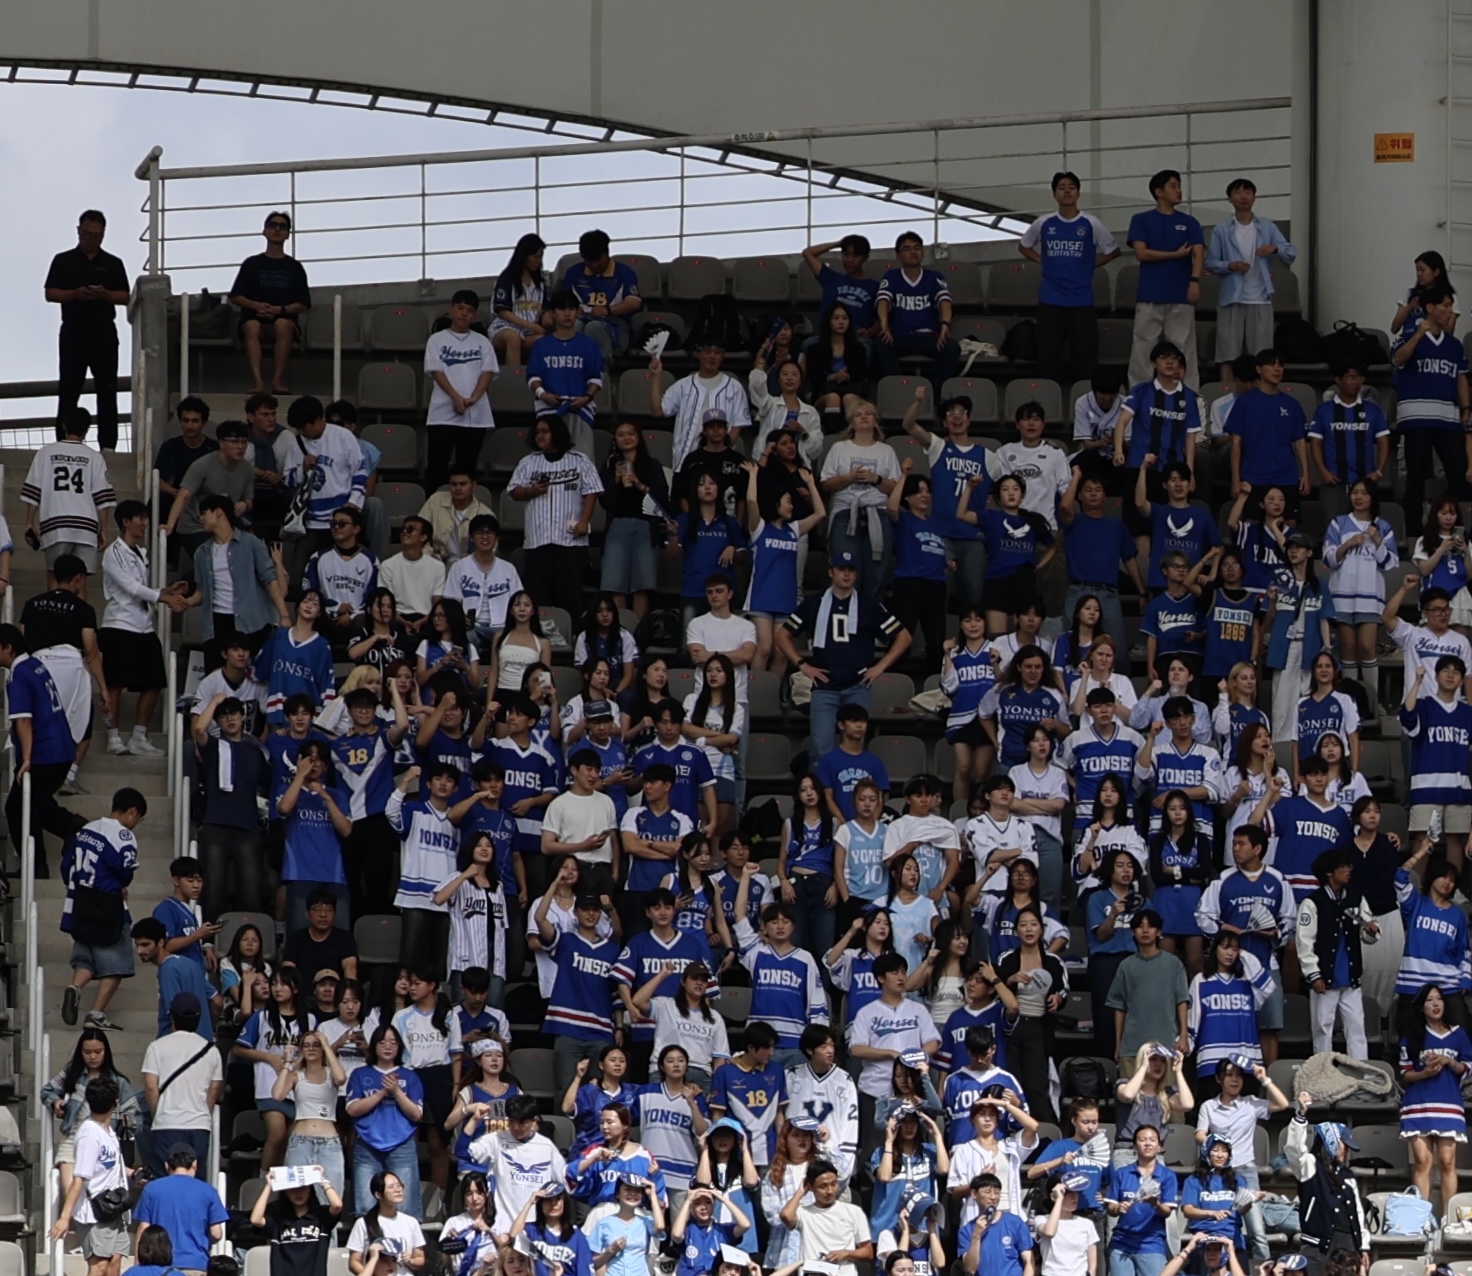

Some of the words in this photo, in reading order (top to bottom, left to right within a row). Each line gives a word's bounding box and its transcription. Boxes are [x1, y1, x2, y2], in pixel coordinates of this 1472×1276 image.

[544, 356, 582, 368] YONSEI
[1330, 422, 1369, 430] YONSEI
[54, 466, 84, 493] 24
[348, 749, 368, 765] 18
[677, 912, 705, 930] 85
[747, 1090, 767, 1107] 18
